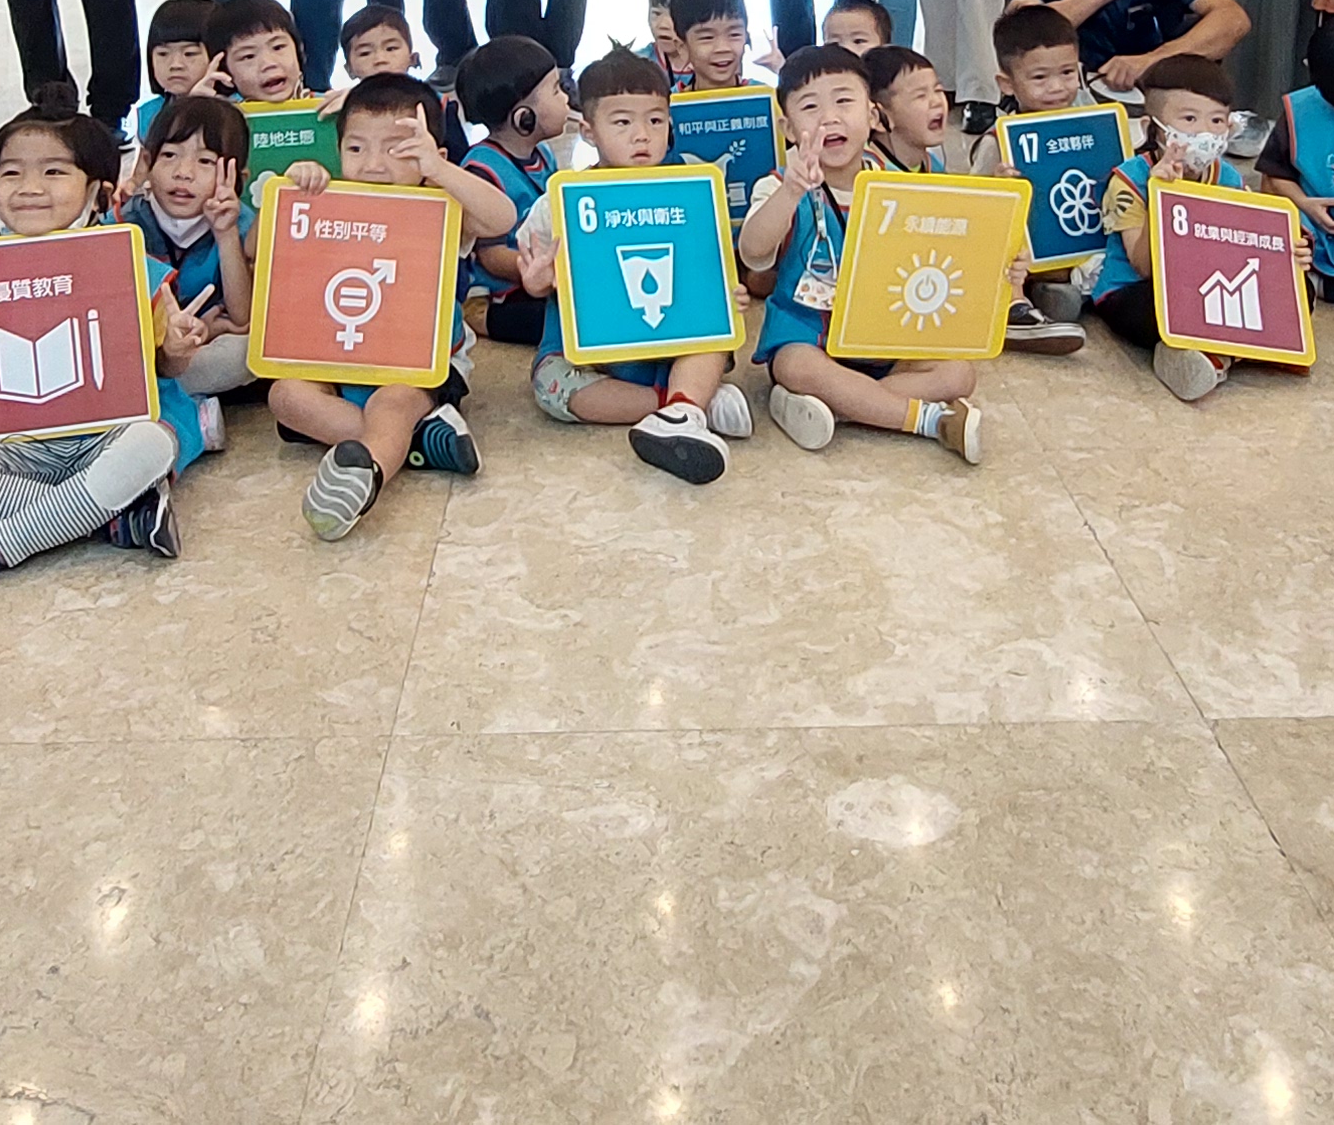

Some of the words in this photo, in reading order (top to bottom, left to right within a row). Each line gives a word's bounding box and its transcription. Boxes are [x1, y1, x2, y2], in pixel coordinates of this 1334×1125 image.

[253, 130, 315, 149] 陸地生態
[1018, 132, 1038, 163] 17
[1046, 134, 1094, 154] 全球夥伴
[290, 201, 311, 240] 5
[314, 218, 388, 243] 性別平等
[577, 196, 598, 233] 6
[604, 206, 687, 228] 淨水與衛生
[878, 199, 898, 235] 7
[1172, 204, 1189, 235] 8
